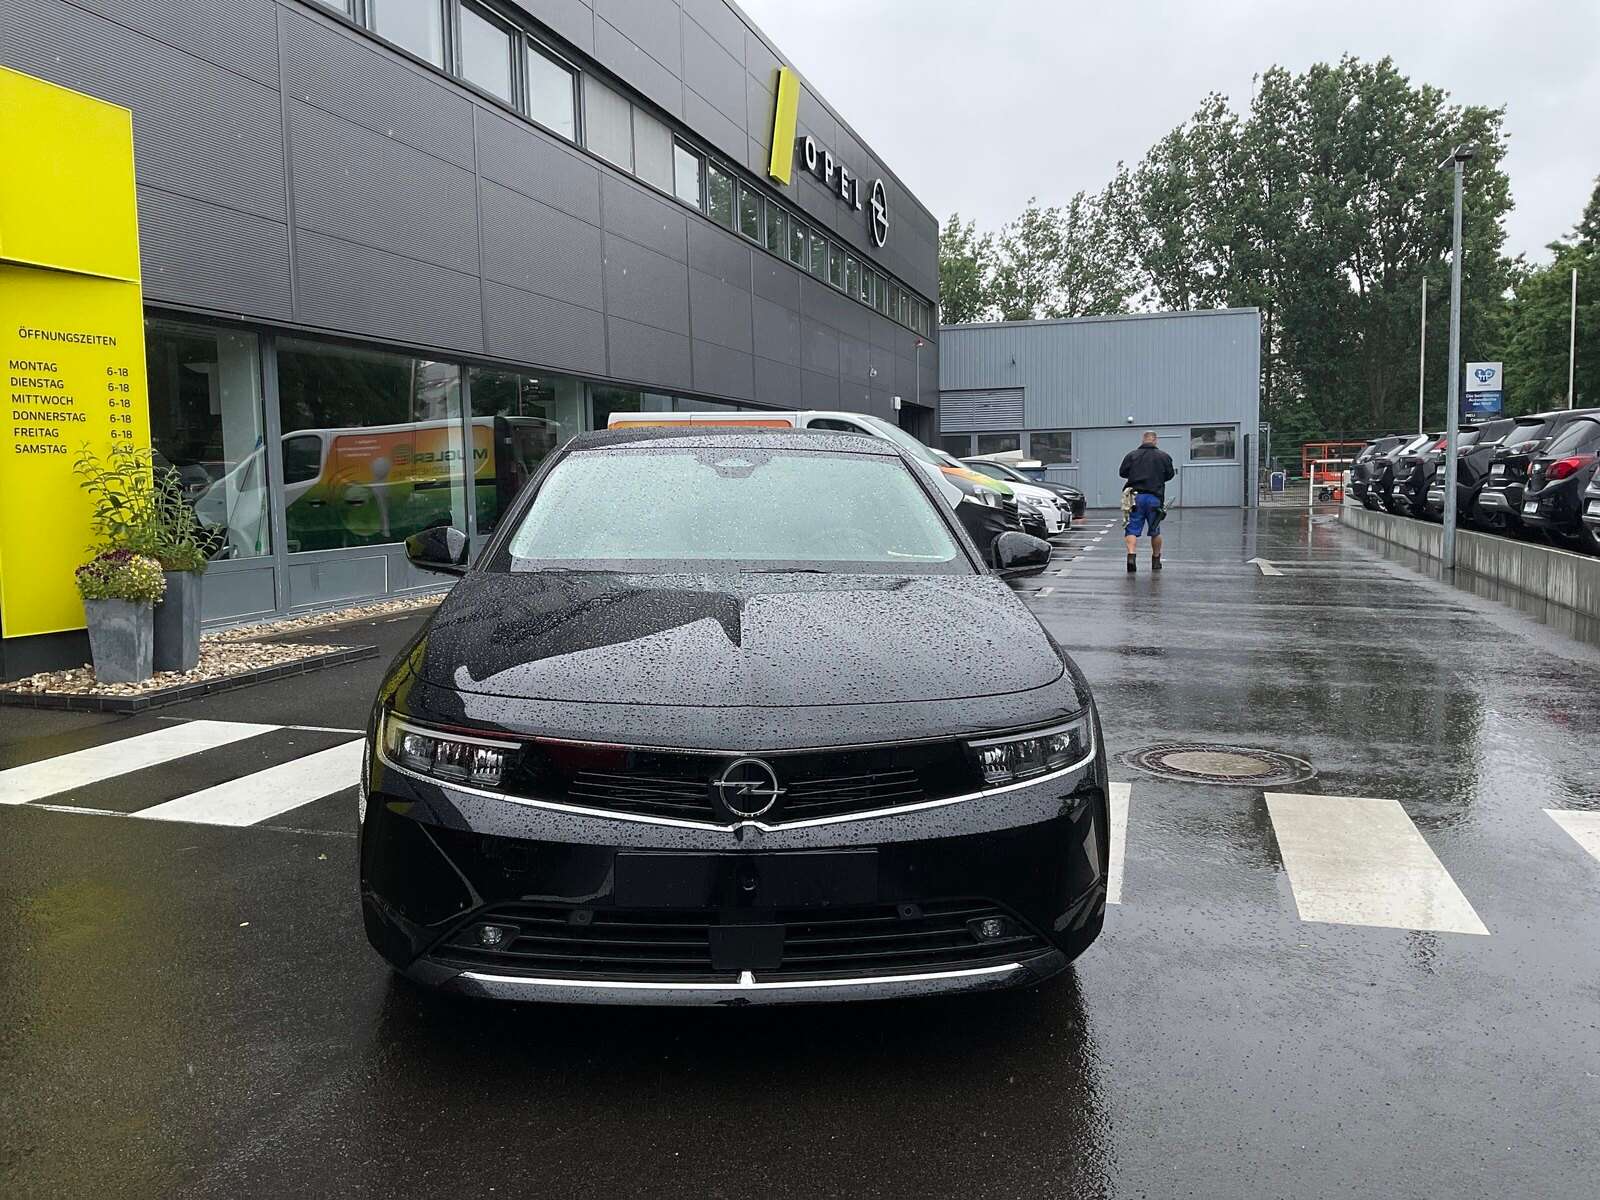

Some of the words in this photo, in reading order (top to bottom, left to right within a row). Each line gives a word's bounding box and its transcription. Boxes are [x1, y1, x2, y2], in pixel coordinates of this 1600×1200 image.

[805, 135, 862, 211] OPEL
[19, 326, 116, 346] ÖFFNUNGSZEITEN
[10, 360, 57, 372] MONTAG
[107, 367, 128, 376] 6-18
[11, 377, 64, 389] DIENSTAG
[108, 383, 129, 392] 6-18
[12, 394, 73, 405] MITTWOCH
[109, 399, 130, 408] 6-18
[13, 411, 86, 422] DONNERSTAG
[110, 414, 131, 423] 6-18
[14, 428, 59, 437] FREITAG
[111, 430, 132, 439] 6-18
[15, 444, 67, 454] SAMSTAG
